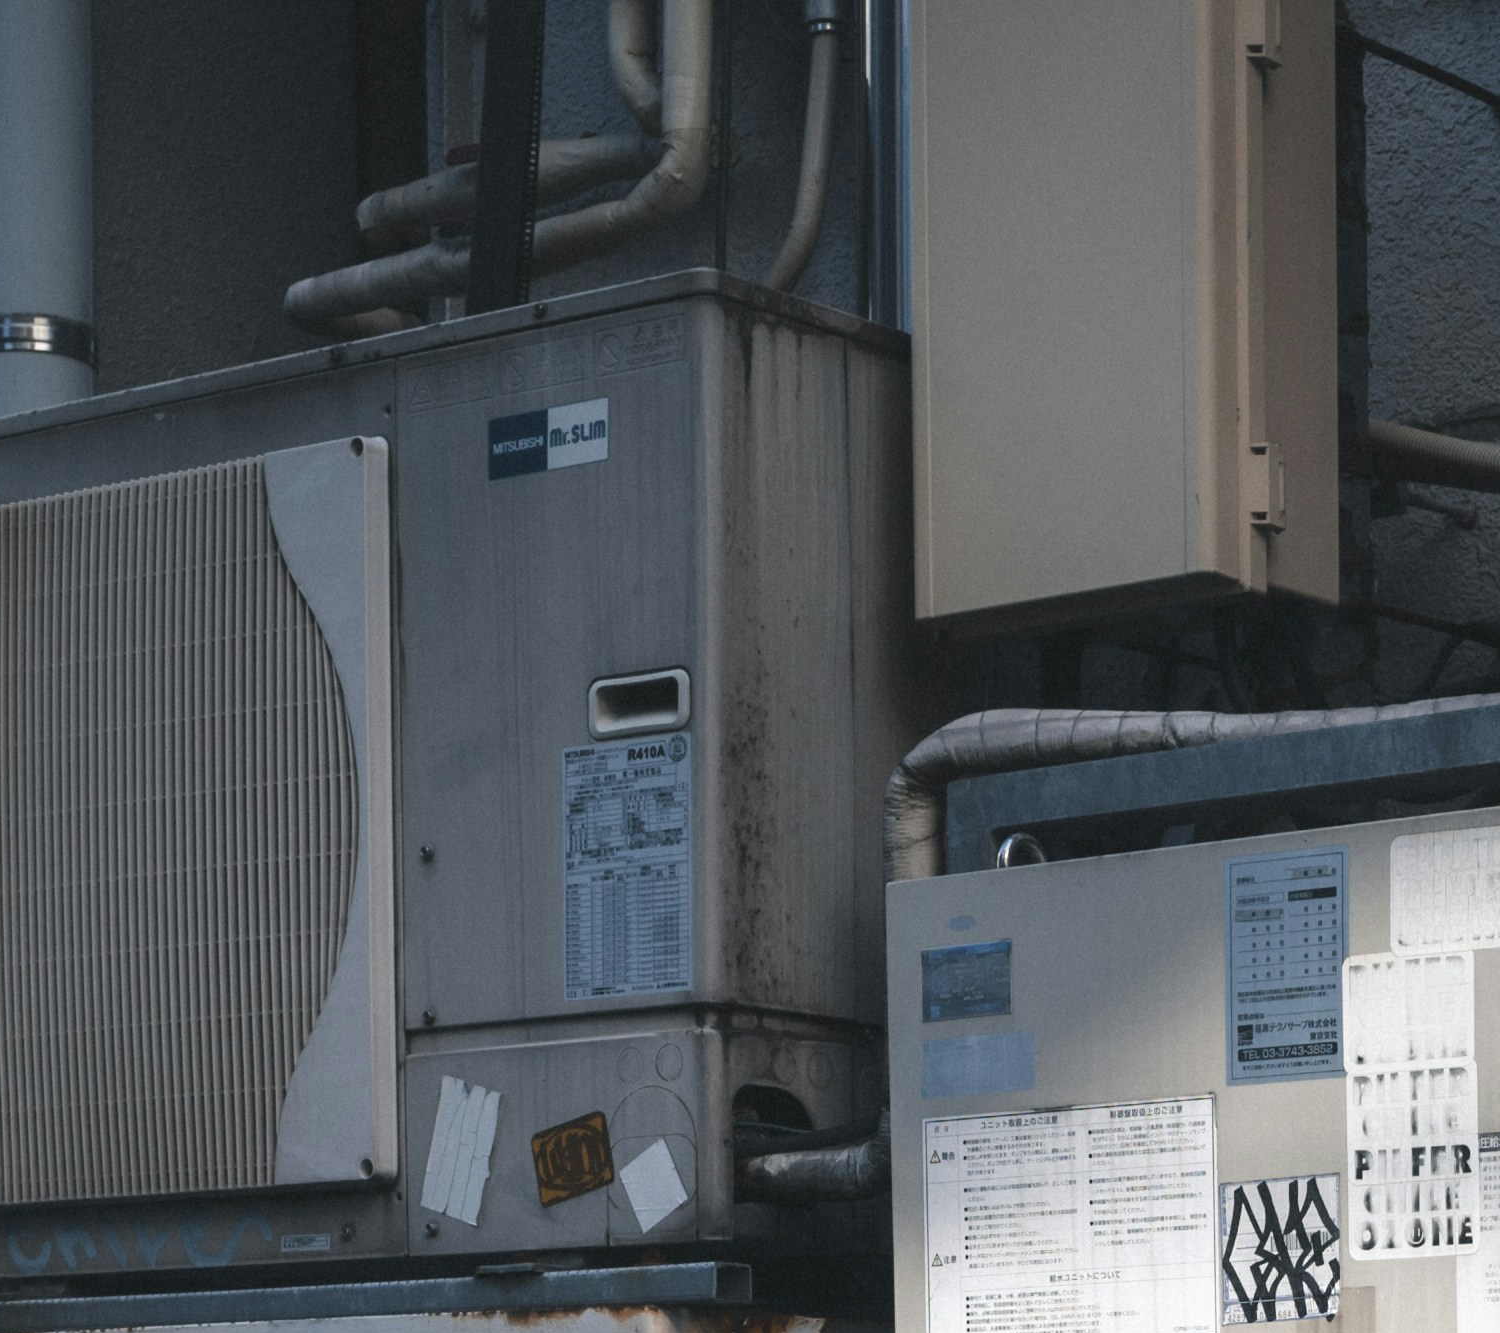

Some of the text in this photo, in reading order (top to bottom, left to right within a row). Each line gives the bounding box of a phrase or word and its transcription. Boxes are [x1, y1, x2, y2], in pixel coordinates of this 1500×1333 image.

[492, 419, 607, 456] MITSUBISHI Mr.SLIM
[628, 745, 665, 761] R410A
[1242, 1045, 1333, 1061] TEL 03-3743-3852
[980, 1115, 1059, 1129] ユニット取扱上のご注意
[1355, 1216, 1474, 1251] OZONE
[1049, 1270, 1121, 1283] 給水ユニットについて
